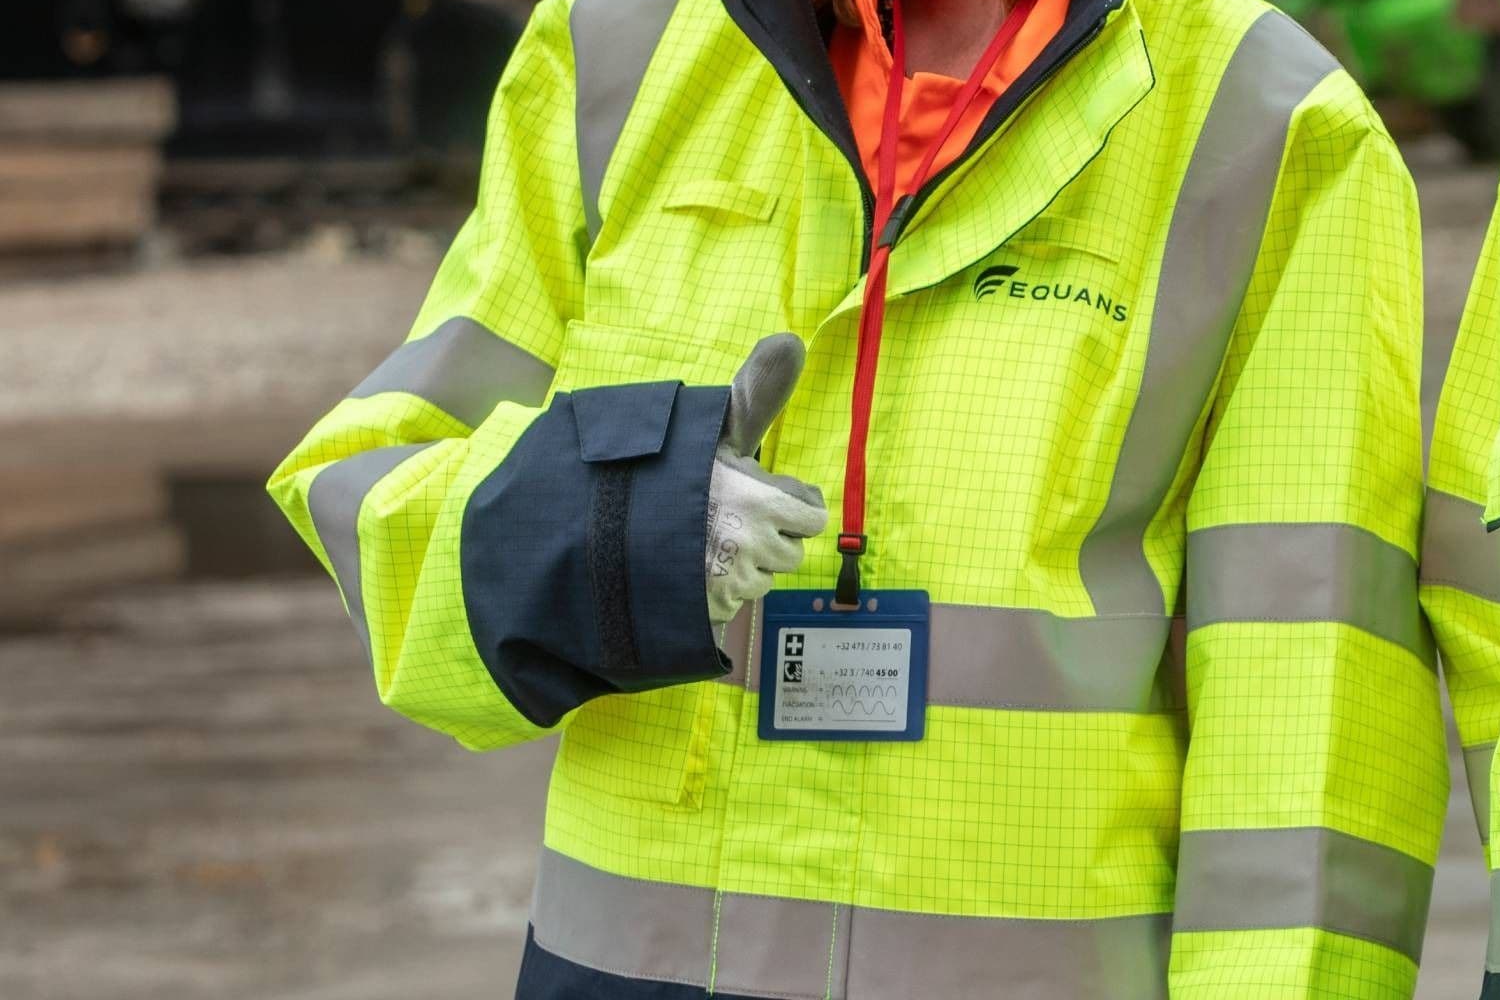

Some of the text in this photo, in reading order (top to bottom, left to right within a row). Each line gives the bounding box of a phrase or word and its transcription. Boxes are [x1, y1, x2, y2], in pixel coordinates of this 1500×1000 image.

[1009, 281, 1127, 322] EQUANS
[876, 669, 886, 677] 45
[888, 669, 898, 677] 00
